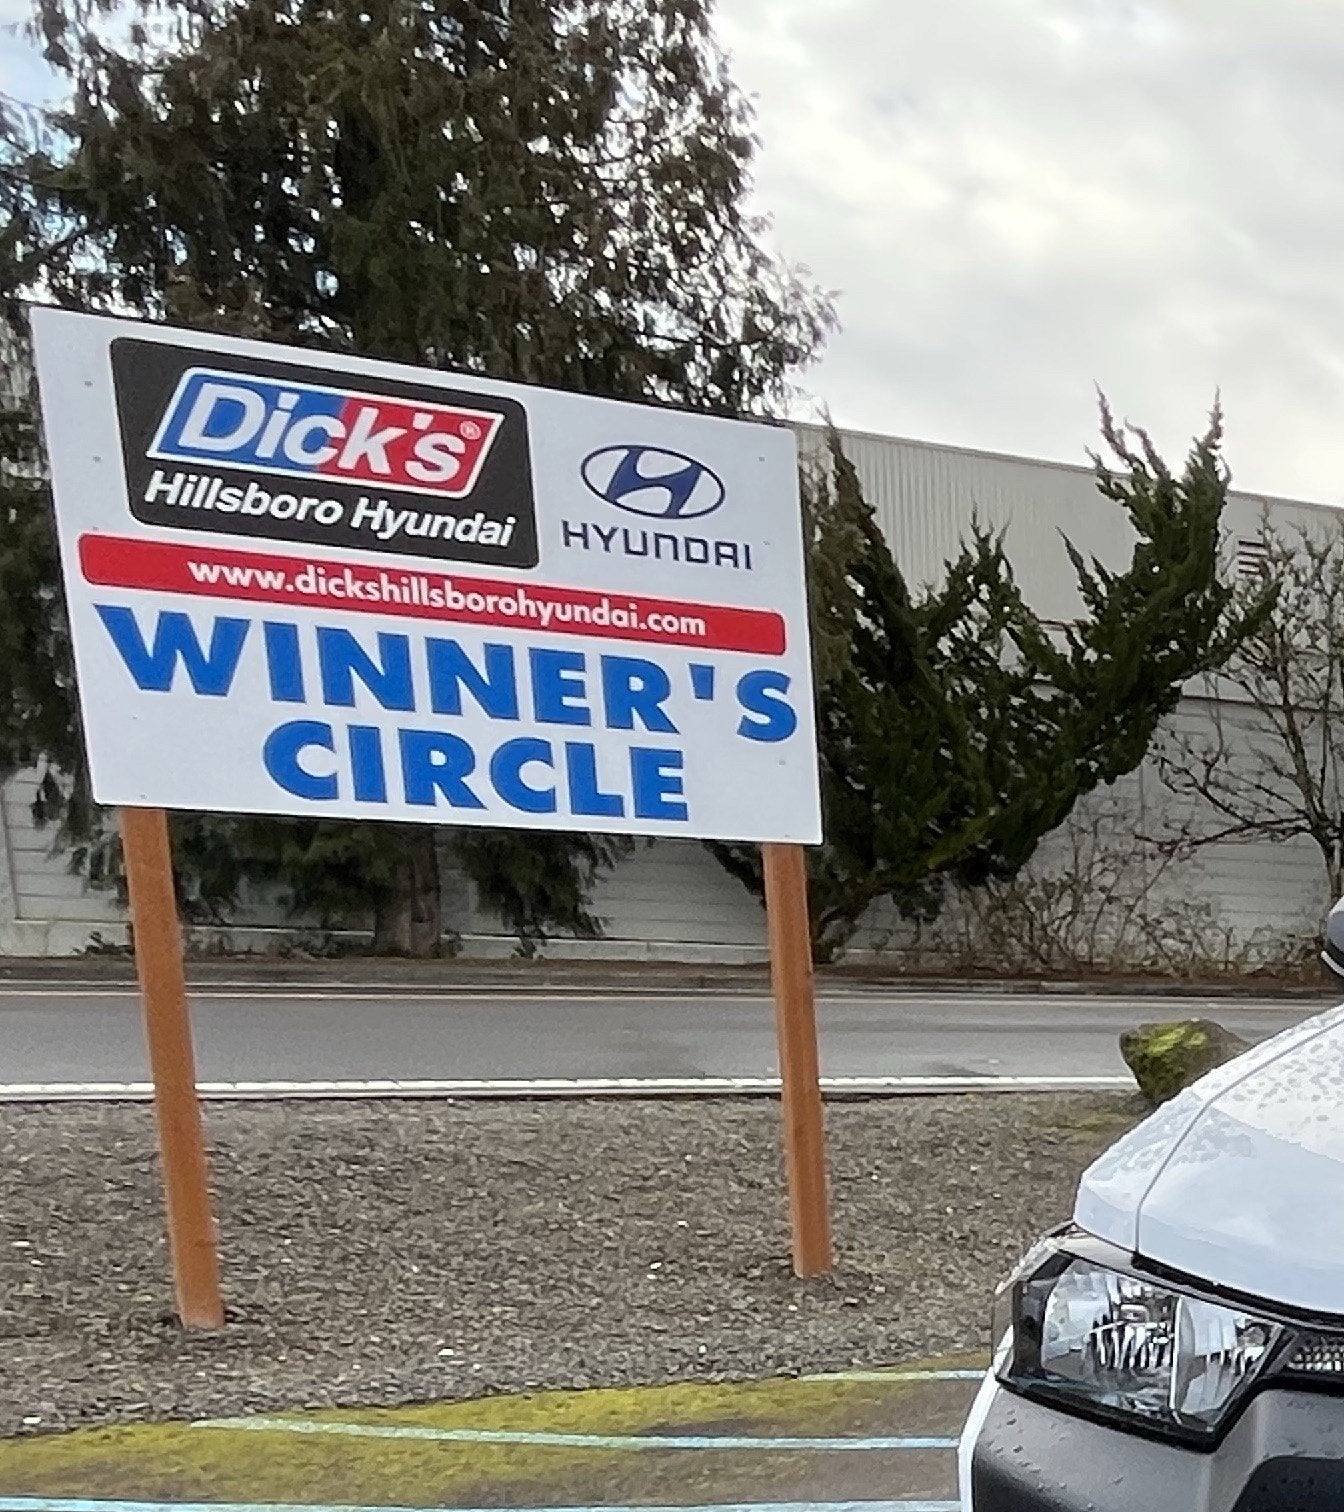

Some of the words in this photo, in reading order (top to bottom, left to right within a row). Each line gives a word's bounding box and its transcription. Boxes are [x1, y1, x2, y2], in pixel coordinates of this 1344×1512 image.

[177, 382, 466, 484] Dick's
[144, 469, 343, 526] Hillsboro
[350, 495, 517, 550] Hyundai
[561, 520, 754, 571] HYUNDAI
[188, 557, 706, 638] www.dickshillsborohyundai.com
[93, 603, 798, 743] WINNER'S
[263, 719, 689, 822] CIRCLE
